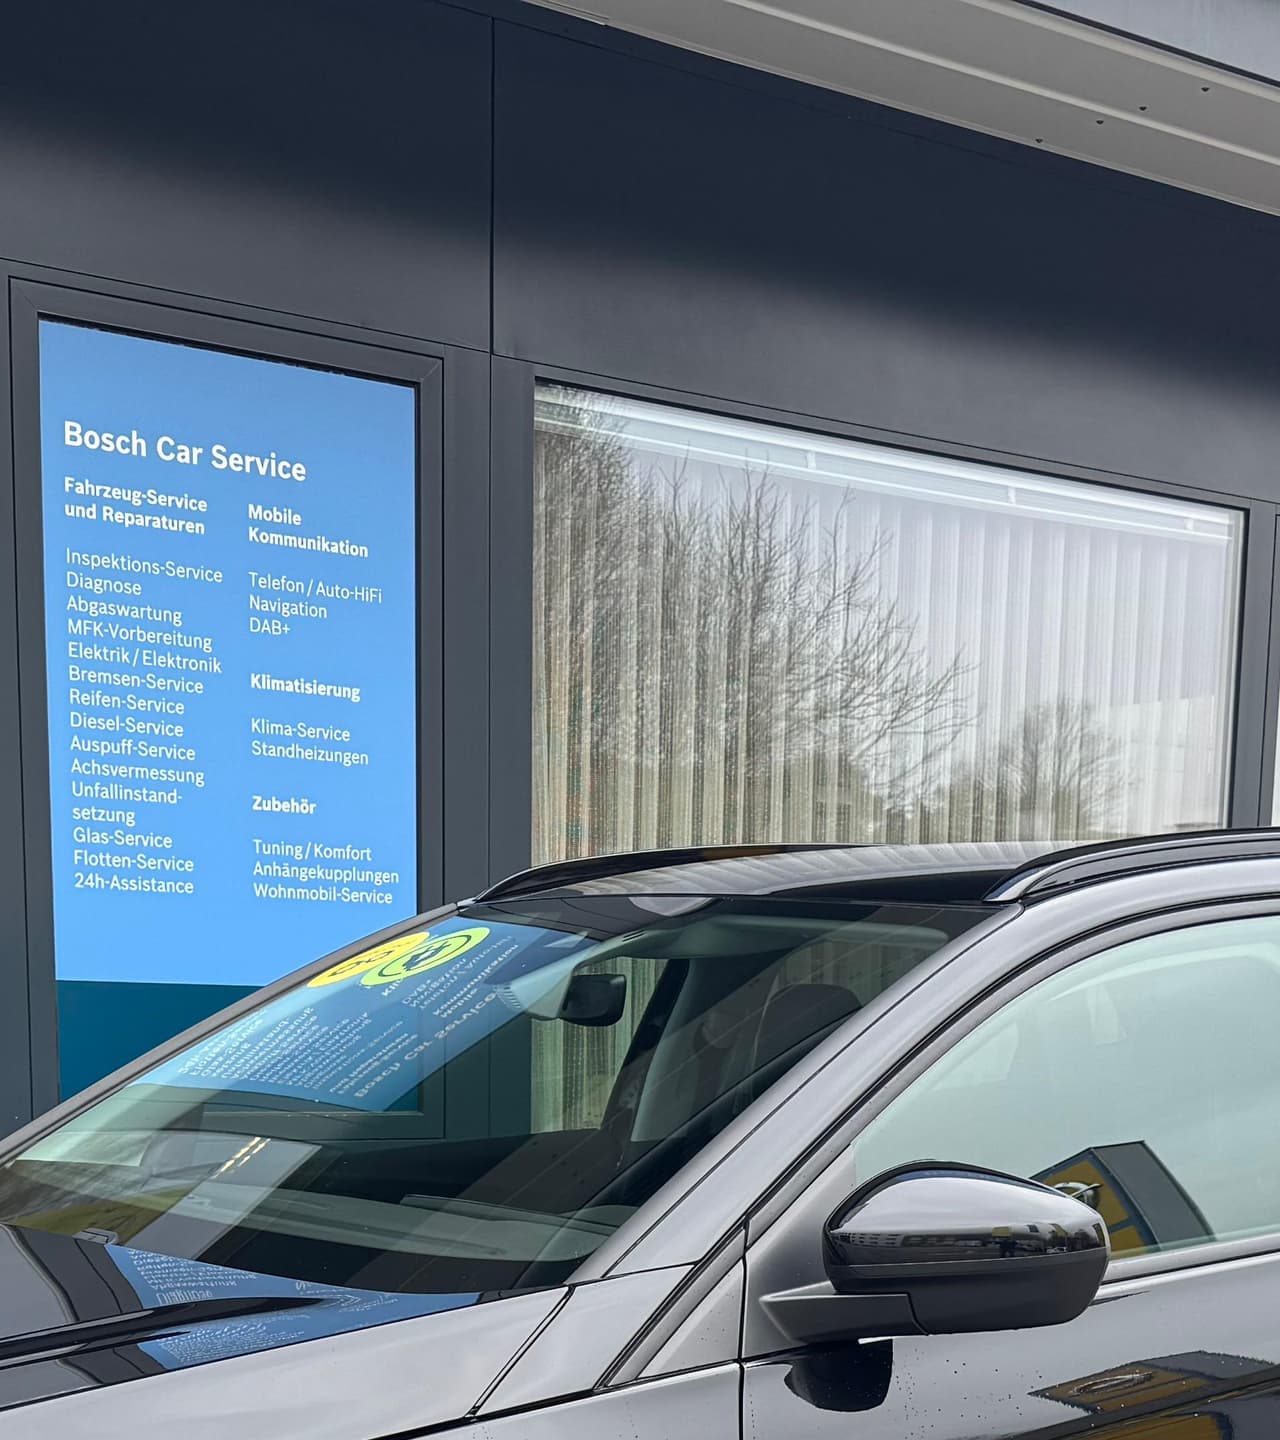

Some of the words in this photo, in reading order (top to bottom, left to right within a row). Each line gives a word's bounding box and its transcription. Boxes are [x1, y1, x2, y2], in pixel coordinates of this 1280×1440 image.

[64, 421, 147, 458] Bosch
[156, 436, 203, 466] Car
[211, 444, 307, 482] Service
[64, 476, 208, 513] Fahrzeug-Service
[64, 502, 97, 521] und
[102, 507, 205, 535] Reparaturen
[248, 503, 302, 527] Mobile
[248, 527, 369, 558] Kommunikation
[66, 547, 223, 583] Inspektions-Service
[66, 571, 143, 597] Diagnose
[248, 572, 305, 595] Telefon
[67, 595, 183, 628] Abgaswartung
[249, 595, 328, 619] Navigation
[67, 619, 213, 653] MFK-Vorbereitung
[249, 617, 291, 636] DAB+
[68, 642, 131, 665] Elektrik
[142, 649, 223, 674] Elektronik
[68, 665, 204, 695] Bremsen-Service
[250, 673, 361, 703] Klimatisierung
[69, 688, 185, 715] Reifen-Service
[70, 711, 184, 738] Diesel-Service
[251, 718, 351, 742] Klima-Service
[70, 735, 196, 762] Auspuff-Service
[251, 741, 369, 767] Standheizungen
[71, 758, 205, 788] Achsvermessung
[72, 781, 183, 805] Unfallinstand-
[252, 796, 317, 816] Zubehör
[72, 806, 136, 827] setzung
[73, 827, 173, 849] Glas-Service
[253, 838, 303, 860] Tuning
[314, 843, 372, 862] Komfort
[73, 850, 195, 873] Flotten-Service
[253, 861, 400, 885] Anhängekupplungen
[74, 872, 194, 894] 24h-Assistance
[253, 883, 393, 905] Wohnmobil-Service
